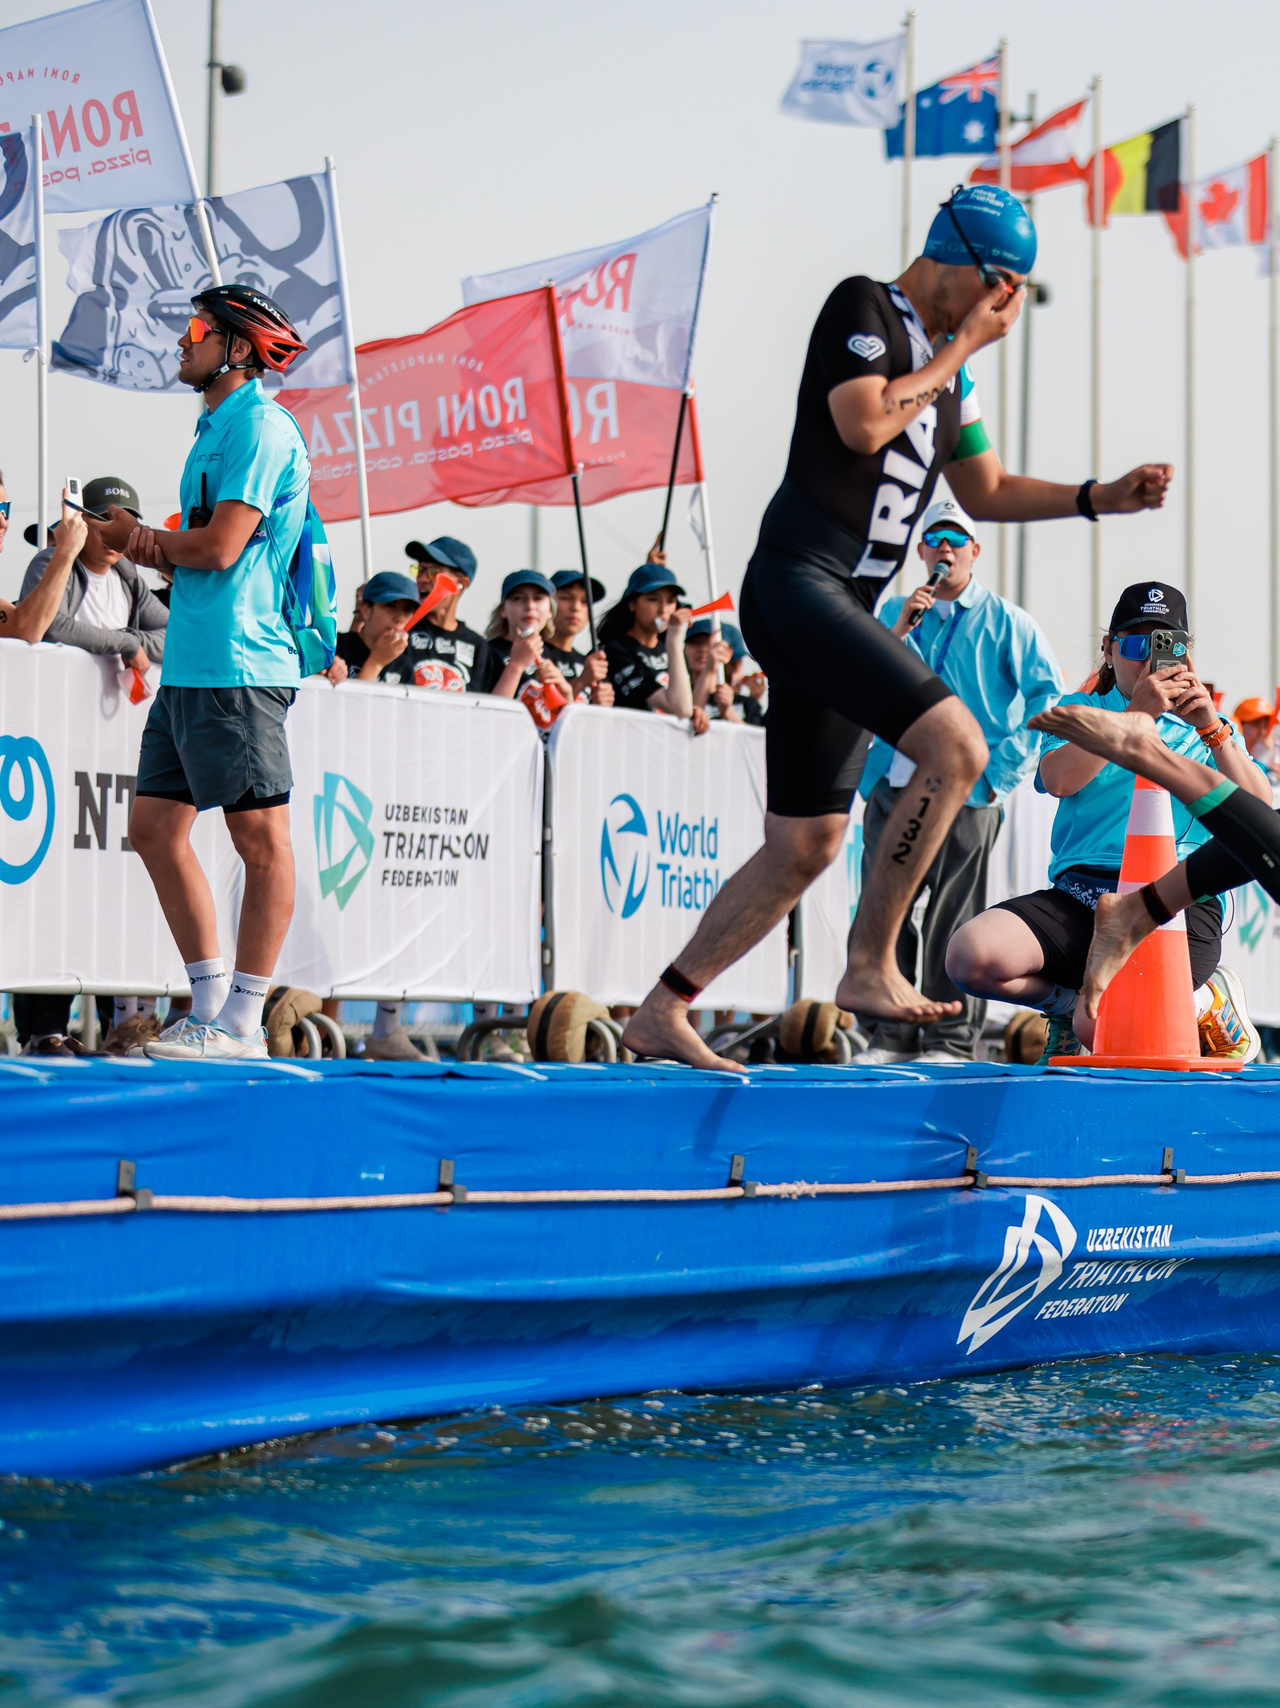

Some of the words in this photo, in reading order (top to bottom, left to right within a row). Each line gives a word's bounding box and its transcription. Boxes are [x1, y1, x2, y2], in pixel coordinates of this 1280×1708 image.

[104, 487, 130, 499] BOSS
[74, 771, 137, 851] NT
[385, 803, 469, 826] UZBEKISTAN
[382, 831, 489, 861] TRIATHLON
[657, 810, 719, 860] World
[381, 868, 460, 887] FEDERATION
[656, 863, 729, 910] Triathl
[1086, 1224, 1173, 1252] UZBEKISTAN
[1058, 1257, 1194, 1291] TRIATHLON
[1034, 1293, 1129, 1320] FEDERATION
